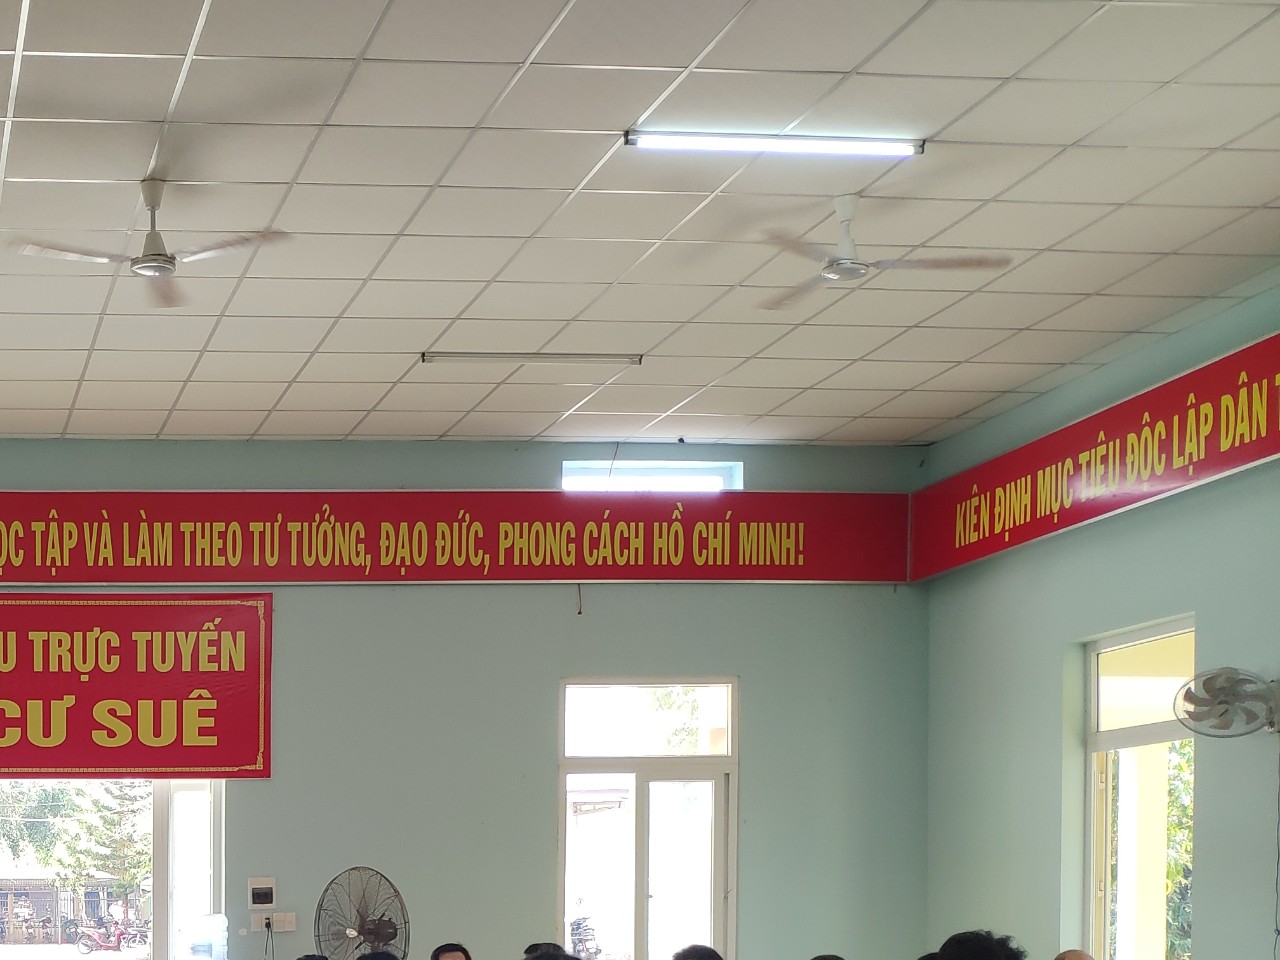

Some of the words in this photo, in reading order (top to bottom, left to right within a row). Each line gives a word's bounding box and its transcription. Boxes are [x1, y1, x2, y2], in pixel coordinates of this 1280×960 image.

[955, 483, 990, 549] KIÊN
[994, 474, 1031, 542] ĐỊNH
[1036, 457, 1074, 524] MỤC
[1078, 430, 1120, 502] TIÊU
[1126, 411, 1166, 492] ĐỘC
[1172, 392, 1214, 476] LẬP
[1220, 371, 1268, 452] DÂN
[32, 509, 77, 576] TẬP
[83, 509, 114, 567] VÀ
[123, 509, 173, 567] LÀM
[180, 521, 242, 567] THEO
[249, 513, 283, 566] TƯ
[287, 504, 371, 575] TƯỞNG,
[379, 521, 428, 575] ĐẠO
[435, 509, 490, 575] ĐỨC,
[498, 521, 575, 566] PHONG
[583, 510, 643, 566] CÁCH
[652, 502, 683, 566] HỒ
[692, 510, 732, 566] CHÍ
[738, 522, 804, 566] MINH!
[28, 627, 120, 681] TRỰC
[132, 617, 246, 672] TUYẾN
[91, 689, 218, 748] SUÊ
